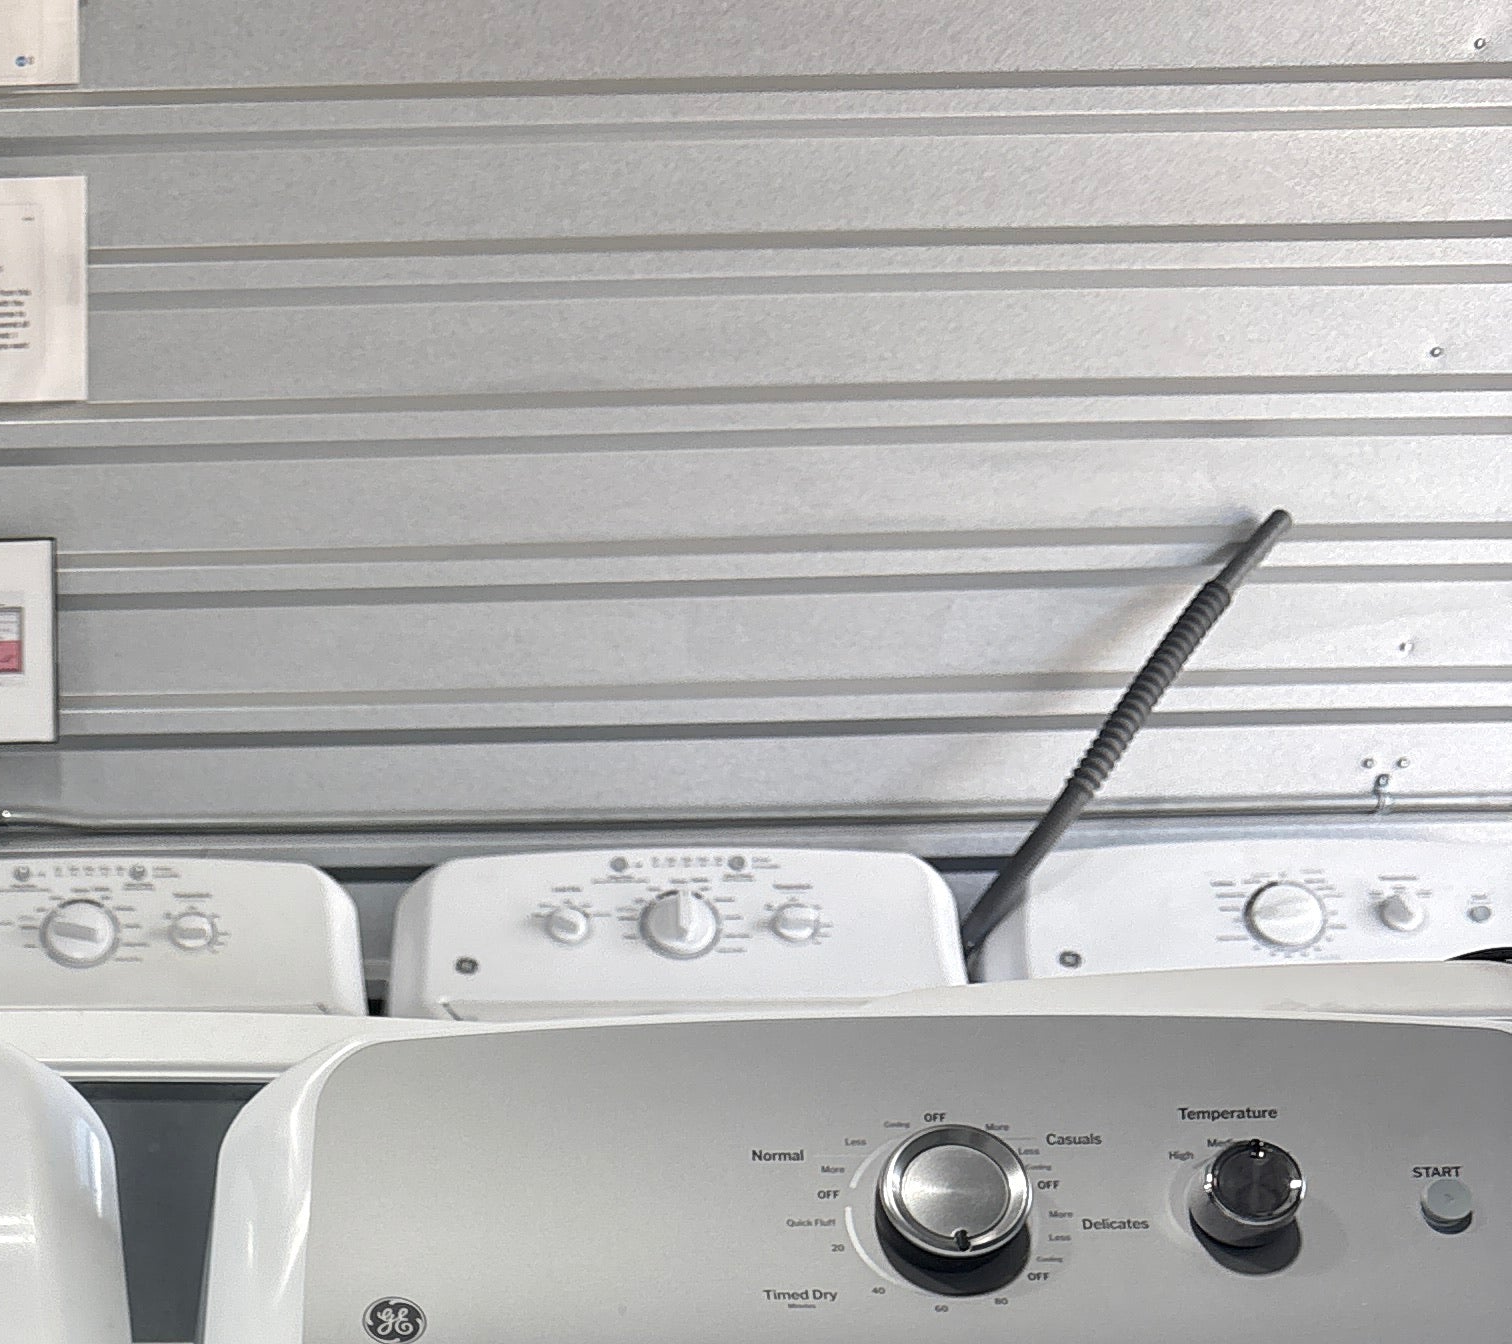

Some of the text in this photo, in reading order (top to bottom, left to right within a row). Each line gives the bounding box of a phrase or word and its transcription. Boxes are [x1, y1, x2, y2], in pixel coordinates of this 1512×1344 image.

[923, 1112, 947, 1123] OFF
[1178, 1107, 1278, 1121] Temperature
[985, 1123, 1010, 1132] More
[844, 1138, 867, 1147] Less
[1046, 1133, 1103, 1146] Casuals
[751, 1149, 805, 1162] Normal
[1168, 1151, 1195, 1161] High
[820, 1165, 845, 1174] More
[1411, 1165, 1462, 1179] START
[1037, 1180, 1060, 1190] OFF
[817, 1189, 841, 1200] OFF
[1048, 1210, 1074, 1219] More
[786, 1218, 837, 1228] Quick Fluff
[1081, 1218, 1150, 1231] Delicates
[1048, 1233, 1072, 1242] Less
[831, 1243, 845, 1252] 20
[1027, 1272, 1050, 1282] OFF
[763, 1289, 838, 1302] Timed Dry
[872, 1286, 886, 1295] 40
